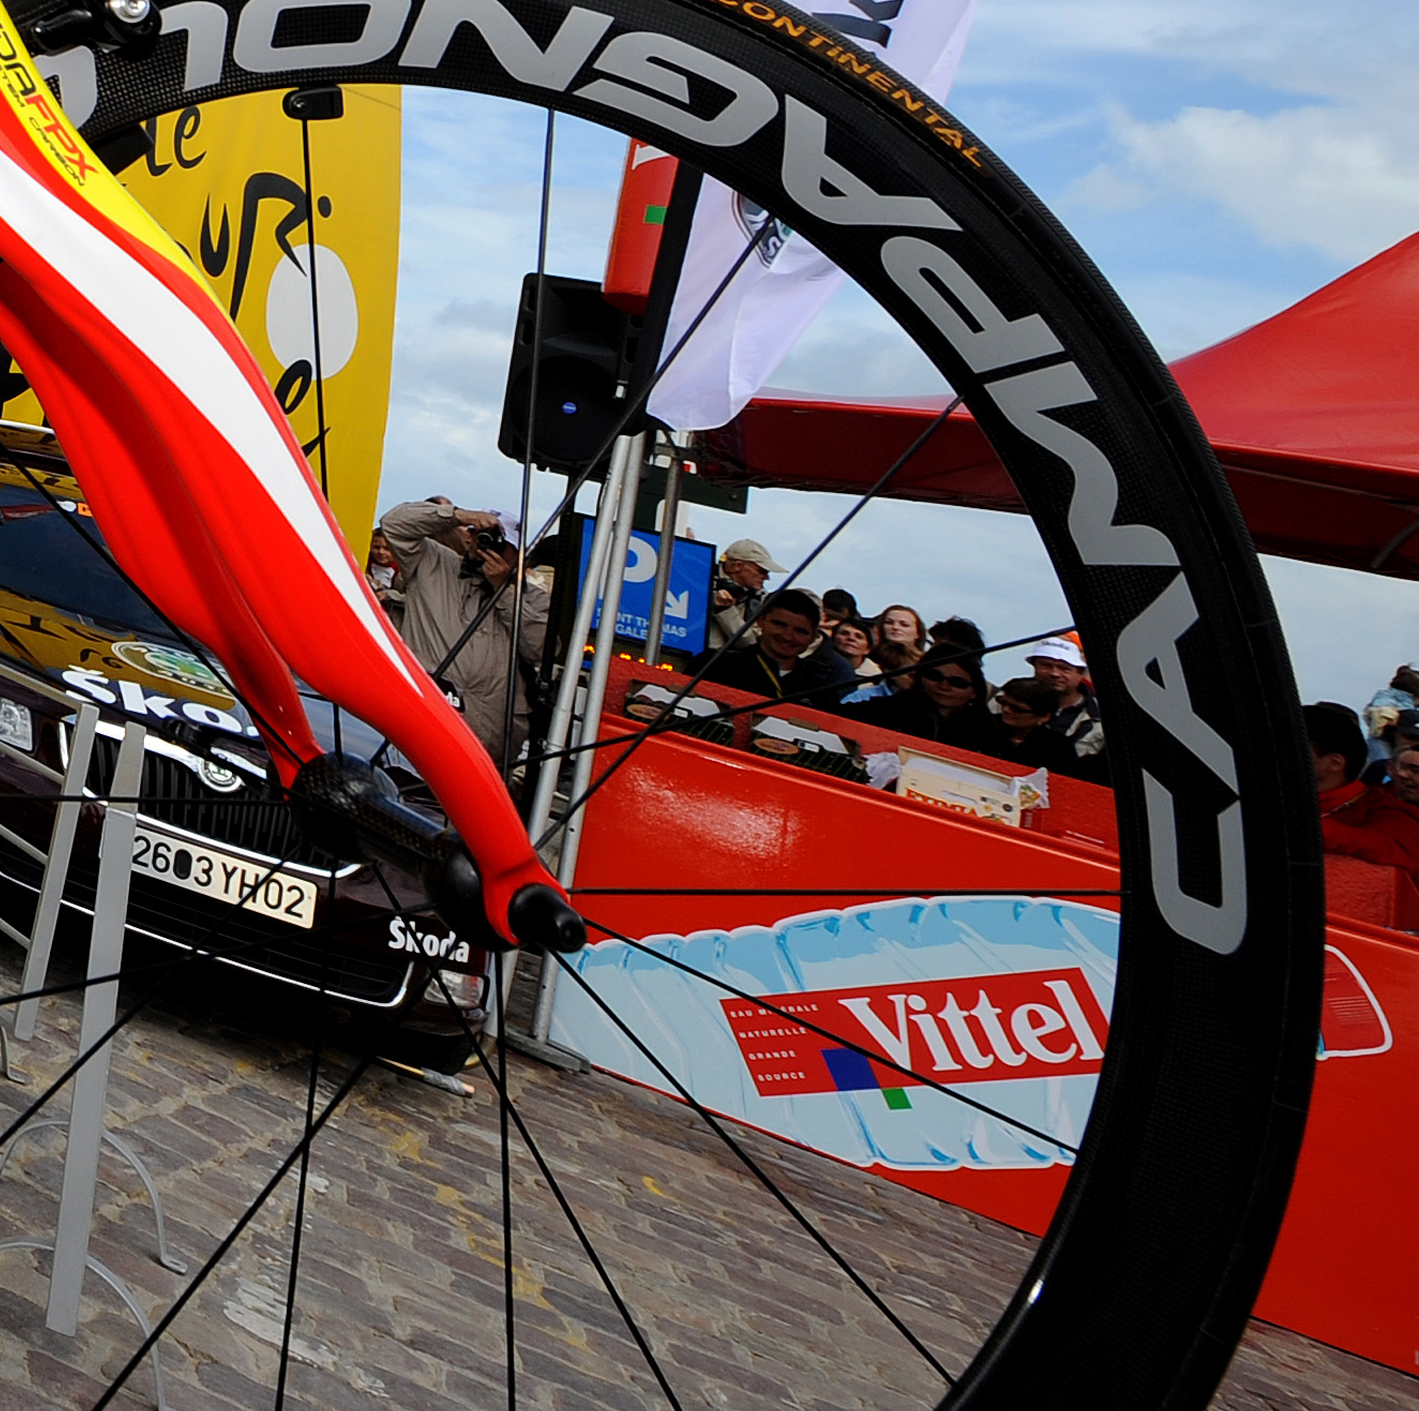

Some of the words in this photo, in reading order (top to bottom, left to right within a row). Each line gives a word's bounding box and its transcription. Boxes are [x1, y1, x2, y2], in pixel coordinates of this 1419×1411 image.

[60, 663, 261, 738] Ško
[837, 979, 1106, 1072] Vittel
[738, 1026, 807, 1039] NATURELLE
[748, 1049, 797, 1061] GRANDE
[757, 1070, 807, 1083] SOURCE
